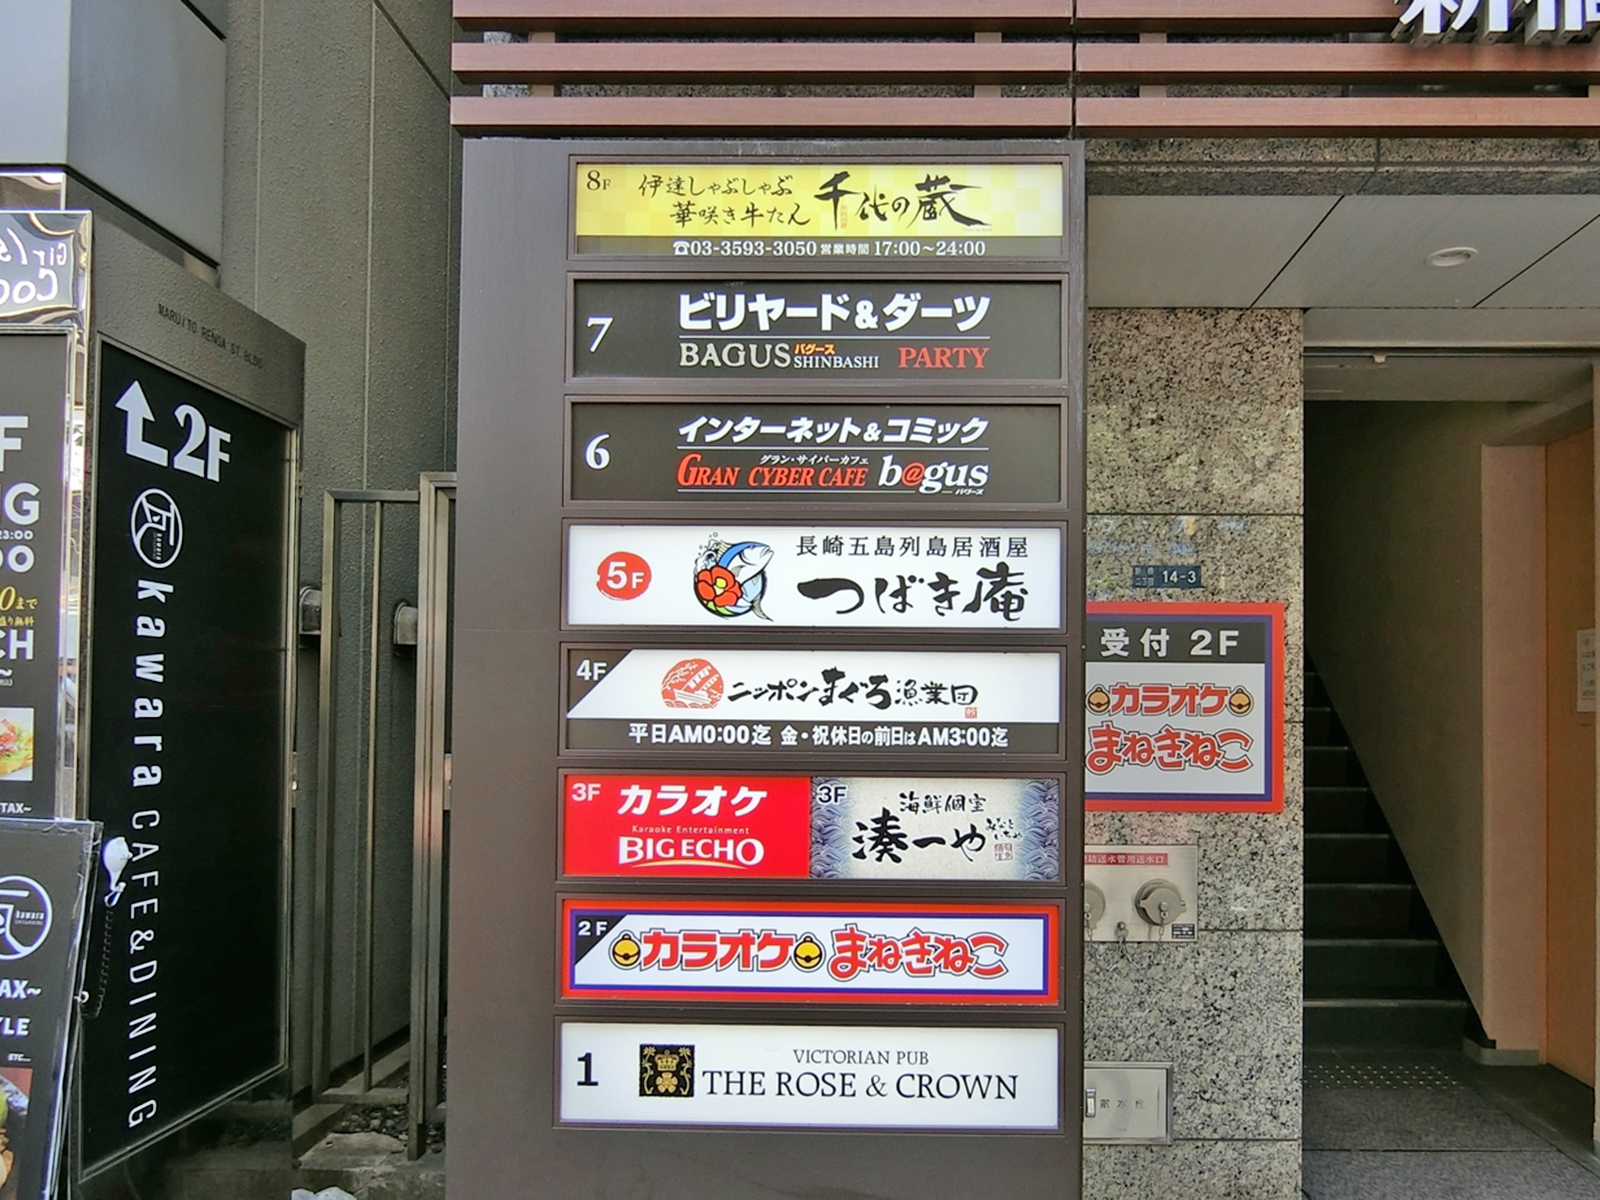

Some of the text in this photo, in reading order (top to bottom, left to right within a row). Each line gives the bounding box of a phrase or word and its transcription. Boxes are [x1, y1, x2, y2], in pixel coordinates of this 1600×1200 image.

[586, 171, 611, 191] 8F
[639, 174, 793, 198] 伊達しゃぶしゃぶ
[670, 201, 811, 228] 華咲き牛たん
[814, 171, 992, 231] 千代の蔵
[691, 241, 817, 256] 03-3593-3050
[820, 243, 869, 255] 営業時間
[679, 292, 991, 332] ビリヤード&ダーツ
[586, 317, 613, 352] 7
[793, 343, 836, 354] バグース
[679, 343, 990, 370] BAGUS SHINBASHI PARTY
[173, 404, 232, 482] 2F
[678, 416, 990, 445] インターネット&コミック
[585, 434, 610, 470] 6
[677, 453, 989, 494] GRAN CYBER CAFE b@gus
[0, 482, 40, 525] G
[796, 535, 1029, 559] 長崎五島列島居酒屋
[606, 560, 645, 590] 5F
[1163, 570, 1196, 583] 14-3
[797, 561, 1029, 622] つばき庵
[1101, 627, 1239, 657] 受付 2F
[132, 579, 174, 787] kawara
[576, 660, 606, 681] 4F
[728, 666, 979, 709] ニッポンまぐろ漁業団
[1110, 683, 1230, 715] カラオケ
[628, 723, 771, 745] 平日AM0:00迄
[1087, 721, 1253, 774] まねきねこ
[572, 783, 601, 801] 3F
[617, 784, 767, 817] カラオケ
[818, 786, 847, 803] 3F
[899, 791, 986, 814] 海鮮個室
[632, 824, 750, 836] Karaoke Entertainment
[852, 807, 986, 863] 湊一や
[618, 836, 764, 865] BIG ECHO
[577, 921, 607, 936] 2F
[641, 925, 1008, 980] カラオケ まねきねこ
[577, 1053, 599, 1087] 1
[793, 1049, 929, 1065] VICTORIAN PUB
[702, 1071, 1018, 1100] THE ROSE & CROWN
